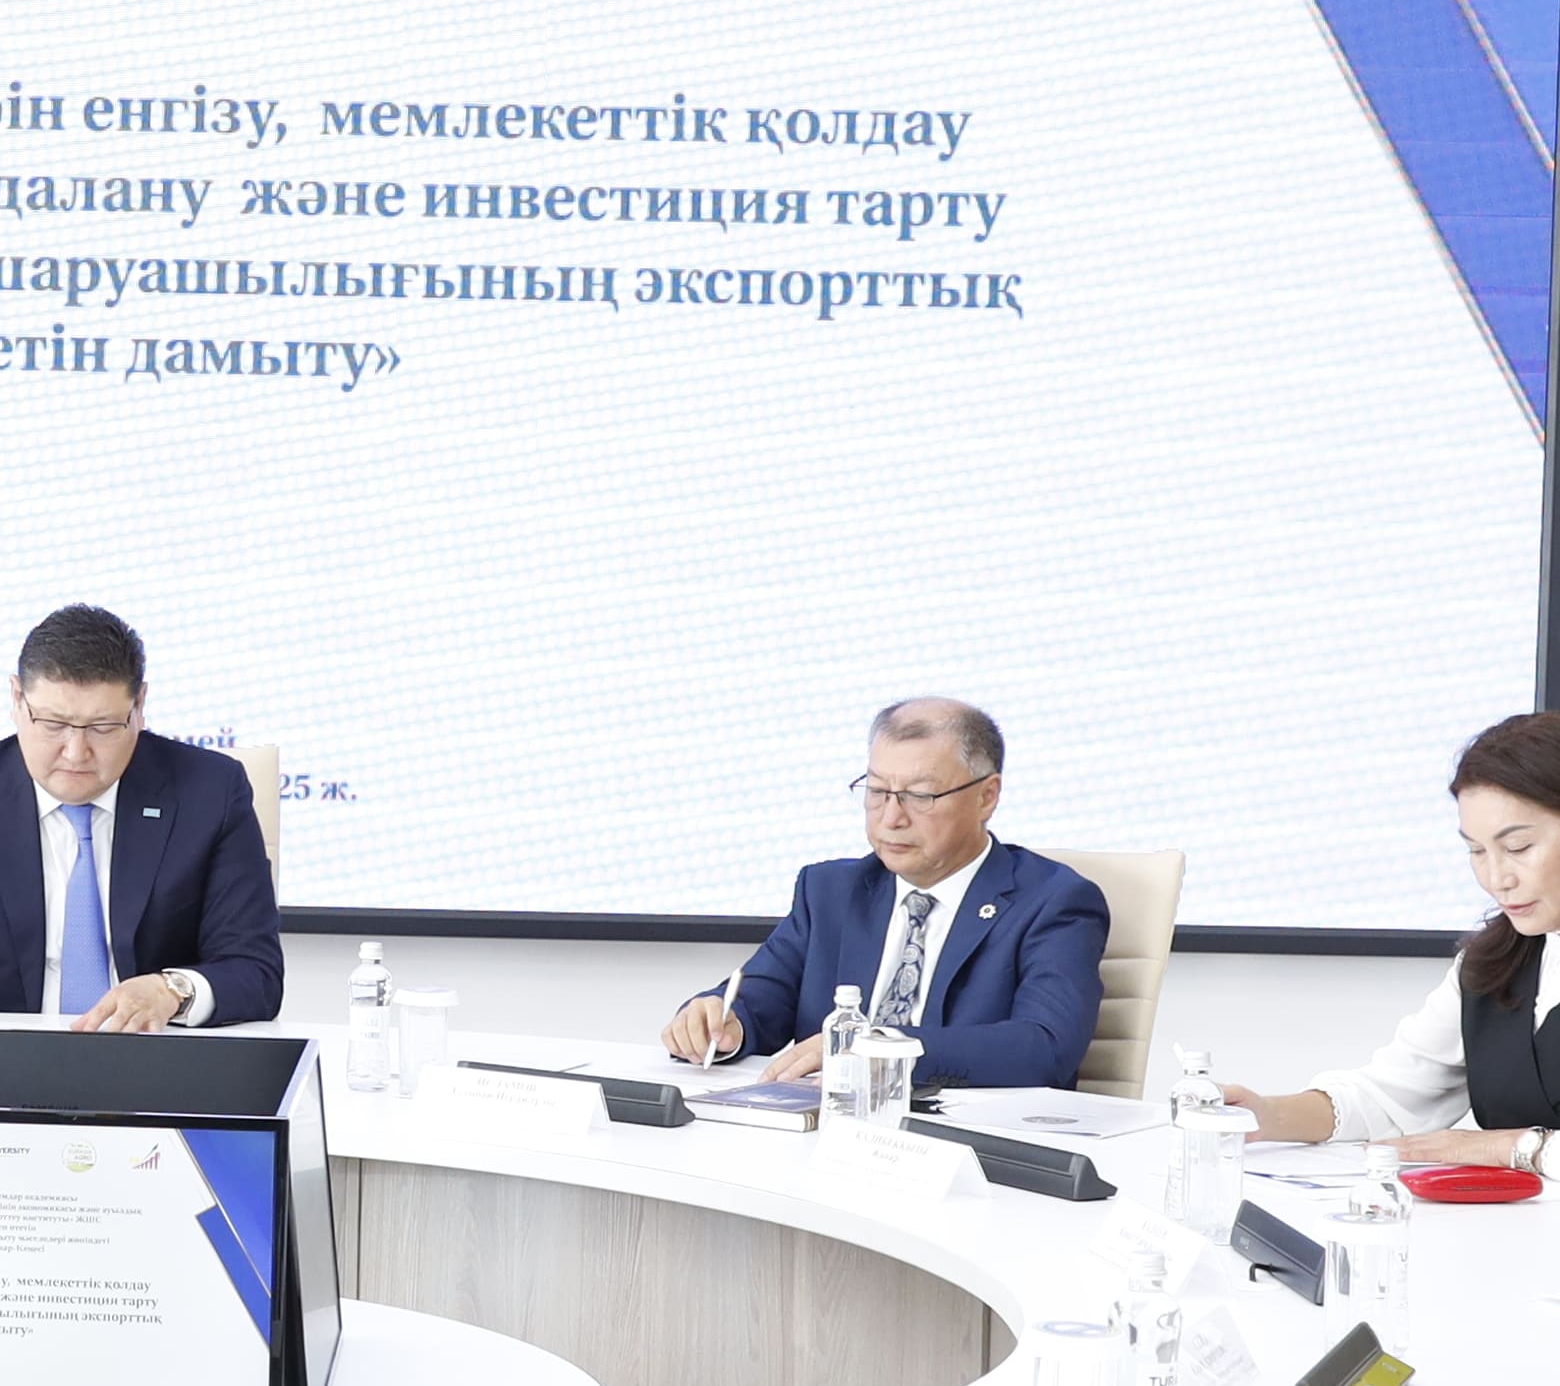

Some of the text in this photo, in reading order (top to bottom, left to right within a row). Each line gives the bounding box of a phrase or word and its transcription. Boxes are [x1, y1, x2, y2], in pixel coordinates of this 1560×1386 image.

[83, 84, 290, 149] енгізу,
[321, 93, 729, 143] мемлекеттік
[745, 108, 973, 163] қолдау
[241, 179, 407, 218] және
[422, 184, 811, 231] инвестиция
[826, 190, 1008, 243] тарту
[634, 268, 1024, 321] экспорттық
[125, 339, 401, 393] дамыту»
[279, 773, 358, 802] 25 ж.
